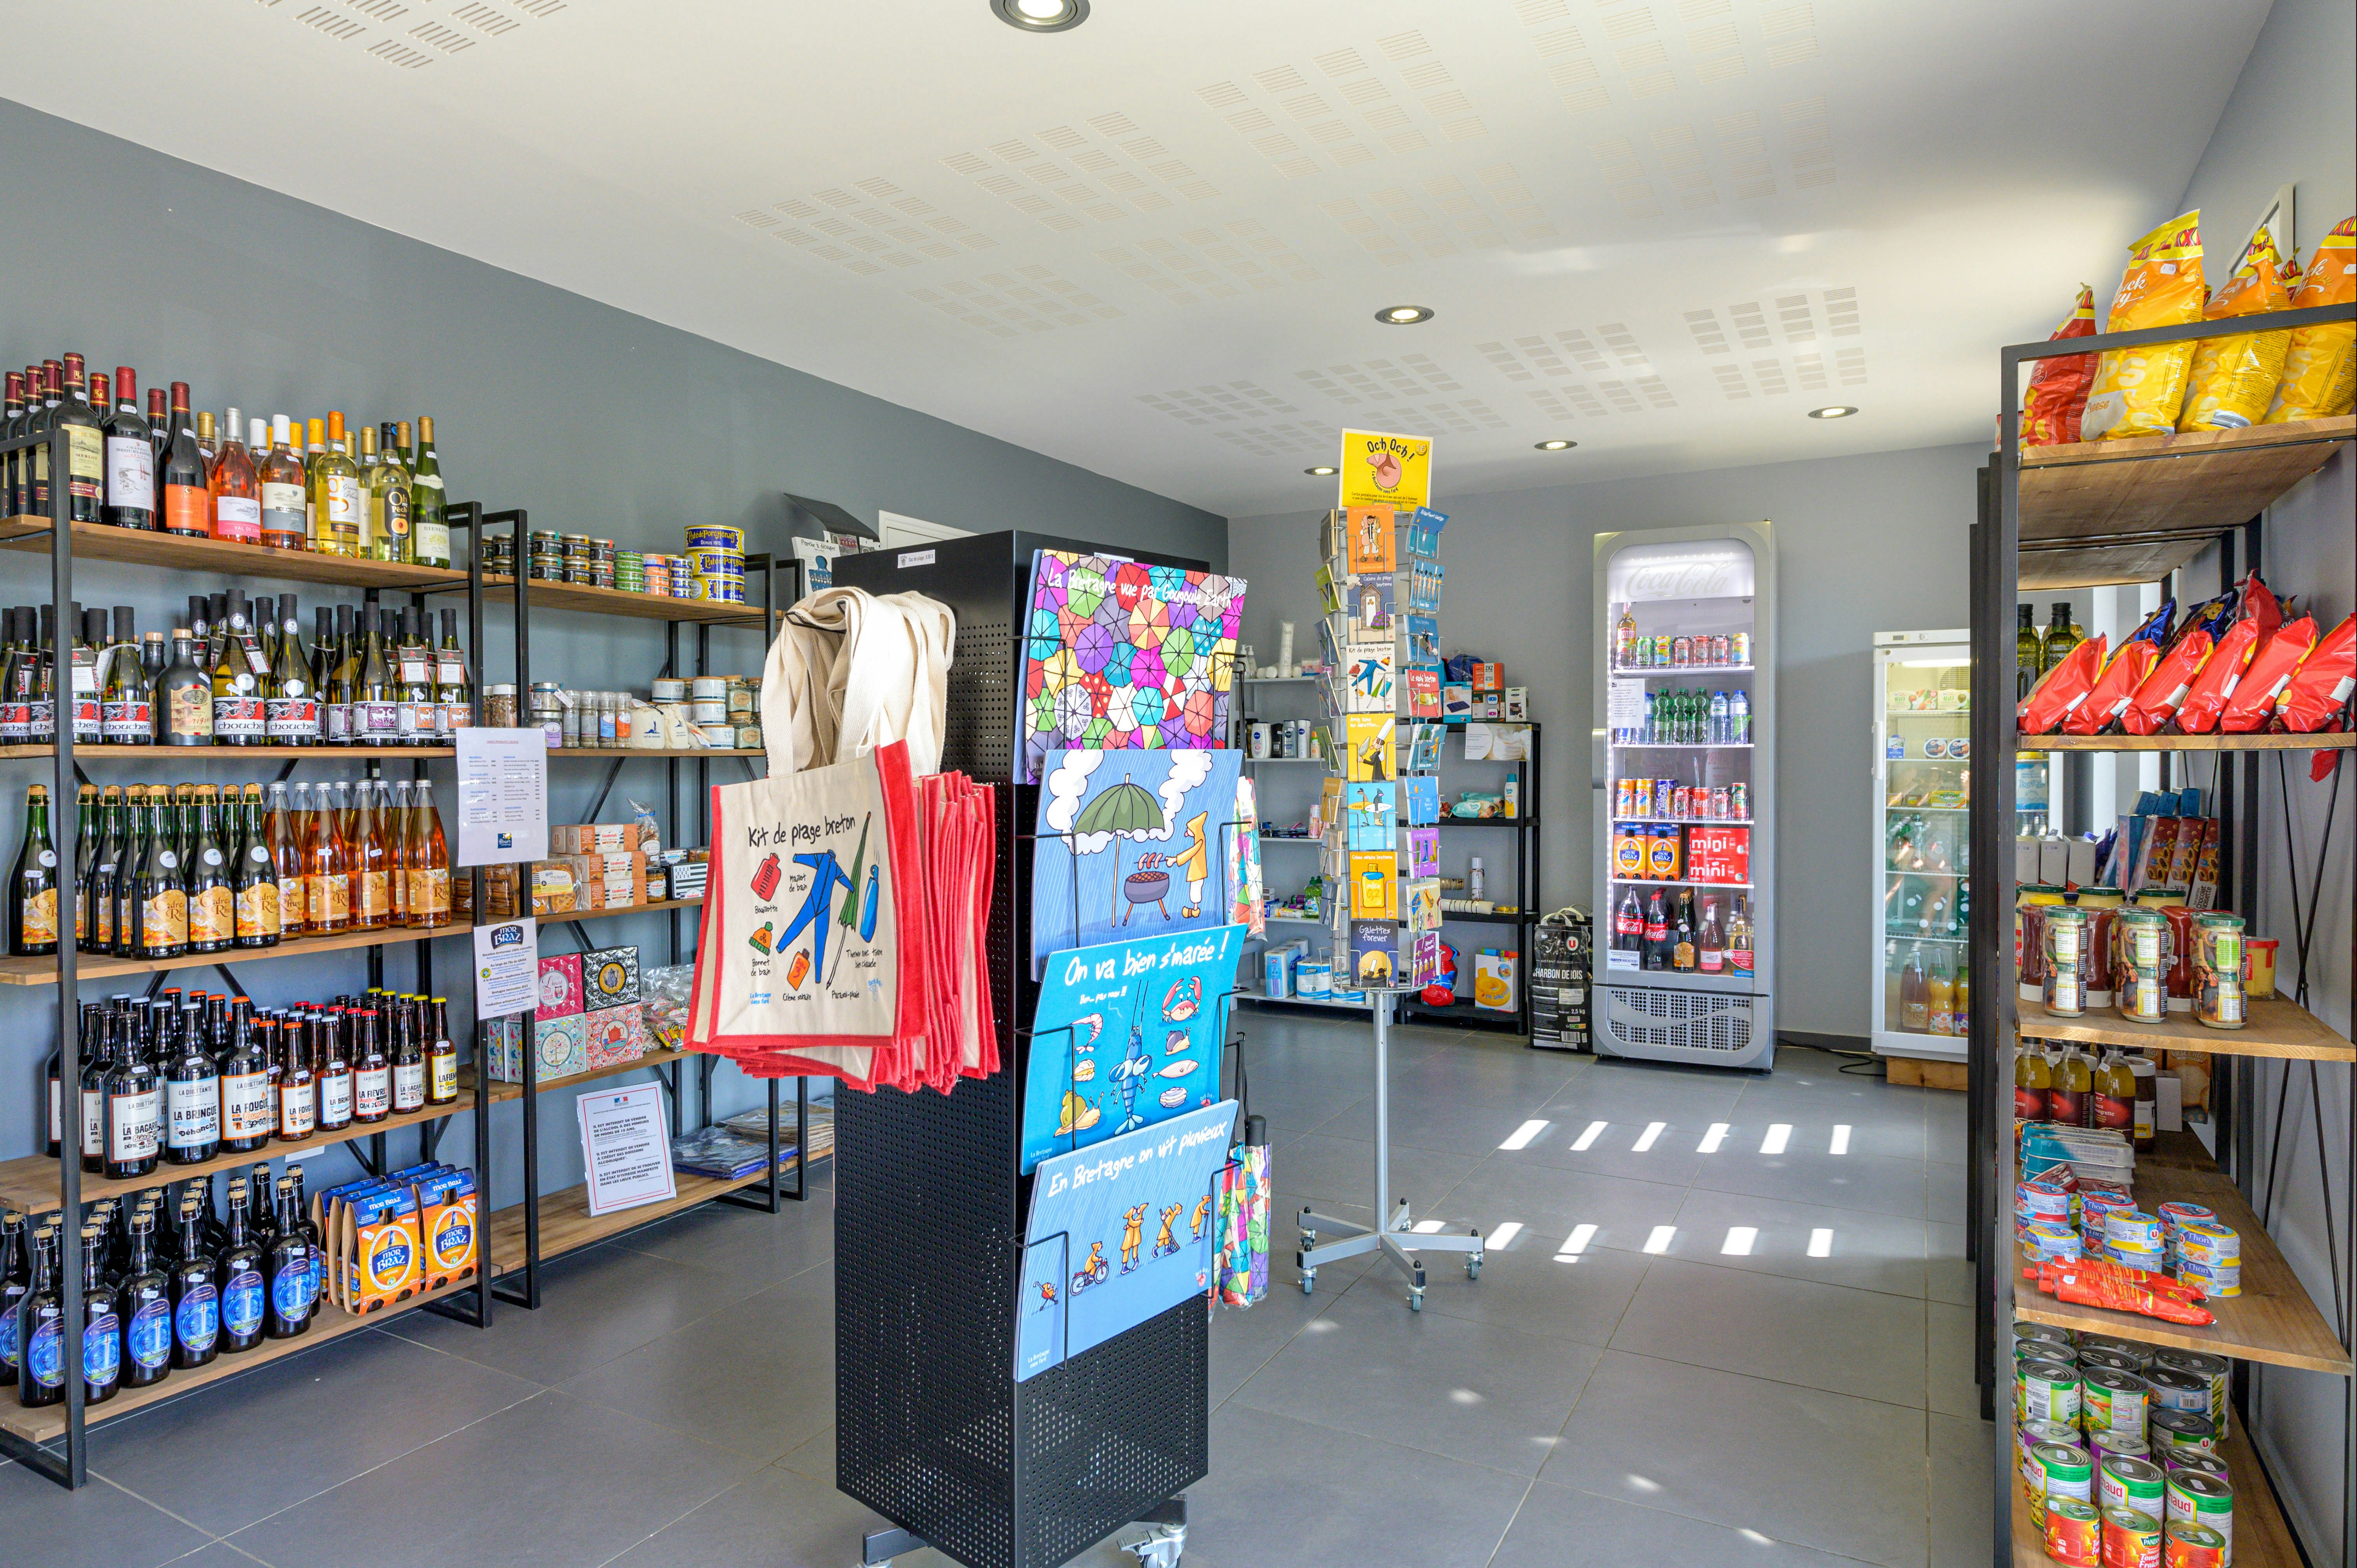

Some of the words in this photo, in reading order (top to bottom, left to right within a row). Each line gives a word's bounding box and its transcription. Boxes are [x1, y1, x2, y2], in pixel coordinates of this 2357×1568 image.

[389, 491, 407, 504] Oh
[1625, 561, 1735, 599] Coca-Cola
[1048, 568, 1062, 588] La
[1067, 570, 1117, 598] Bretagne
[1121, 583, 1138, 597] vue
[1140, 585, 1159, 602] par
[1162, 584, 1201, 607] Gougoule
[1204, 589, 1232, 610] Earth
[1410, 674, 1415, 682] Le
[1424, 675, 1436, 683] breton
[748, 826, 768, 848] Kit
[774, 822, 786, 844] de
[792, 823, 822, 847] plage
[825, 813, 856, 837] breton
[1692, 837, 1727, 850] mini
[1691, 864, 1725, 877] mini
[789, 874, 807, 883] Maillot
[789, 884, 795, 893] de
[797, 883, 807, 892] bain
[2196, 886, 2206, 908] Chocolat
[1359, 925, 1390, 934] Galettes
[1363, 934, 1387, 942] forever
[1568, 939, 1576, 948] U
[752, 959, 770, 967] Bonnet
[1065, 956, 1088, 986] On
[1095, 959, 1115, 981] va
[1122, 948, 1156, 976] bien
[1159, 937, 1215, 969] s'marée
[1562, 969, 1569, 979] DE
[1571, 969, 1583, 979] BOIS
[783, 993, 795, 1001] Crème
[174, 1112, 182, 1121] LA
[186, 1105, 217, 1118] BRINGUE
[1048, 1172, 1068, 1198] En
[1072, 1155, 1134, 1190] Bretagne
[1139, 1149, 1153, 1164] on
[1158, 1138, 1178, 1159] vit
[1179, 1121, 1228, 1155] pluvieux
[2087, 1201, 2105, 1211] Thon
[2187, 1232, 2209, 1244] Thon
[2187, 1262, 2209, 1274] Thon
